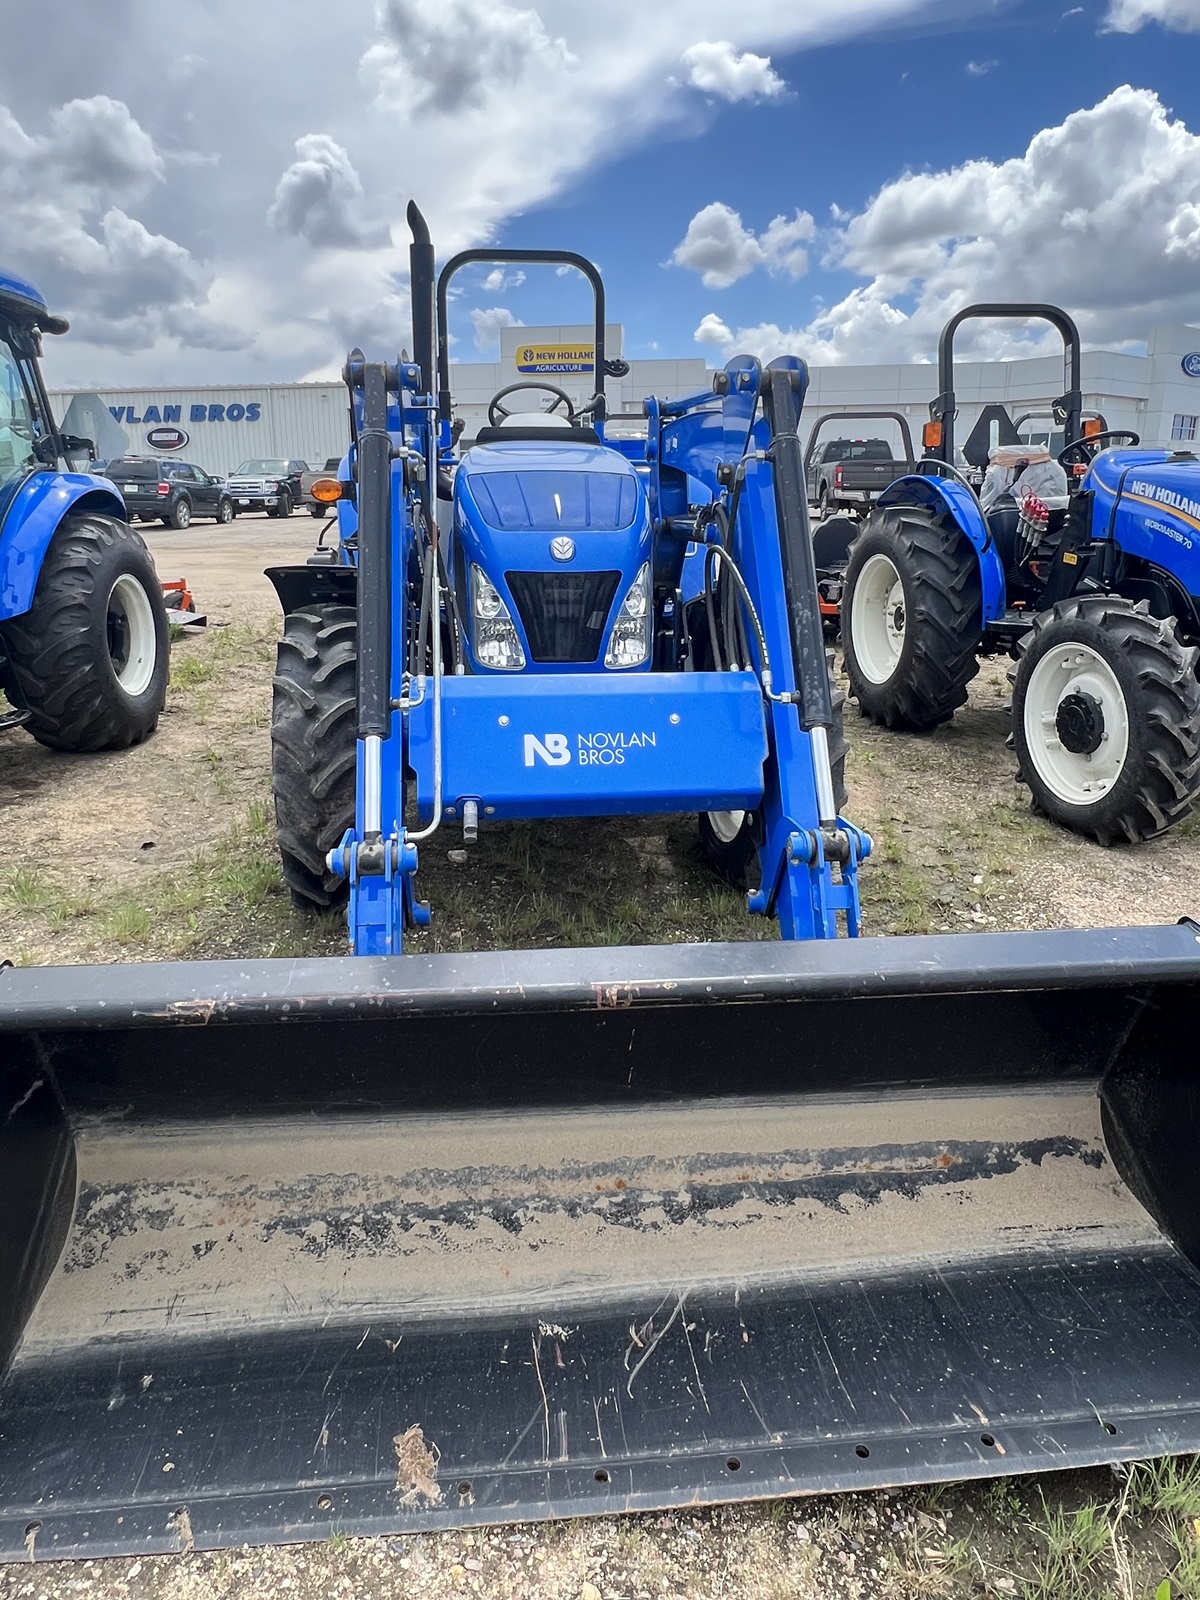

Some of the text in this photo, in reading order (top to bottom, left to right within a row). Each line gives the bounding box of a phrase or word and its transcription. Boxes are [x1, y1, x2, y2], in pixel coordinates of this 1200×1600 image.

[536, 352, 556, 360] NEW
[189, 402, 262, 423] BROS
[1131, 480, 1156, 498] NEW
[1144, 518, 1193, 549] WORKMASTER 70
[577, 732, 657, 748] NOVLAN
[579, 748, 625, 765] BROS
